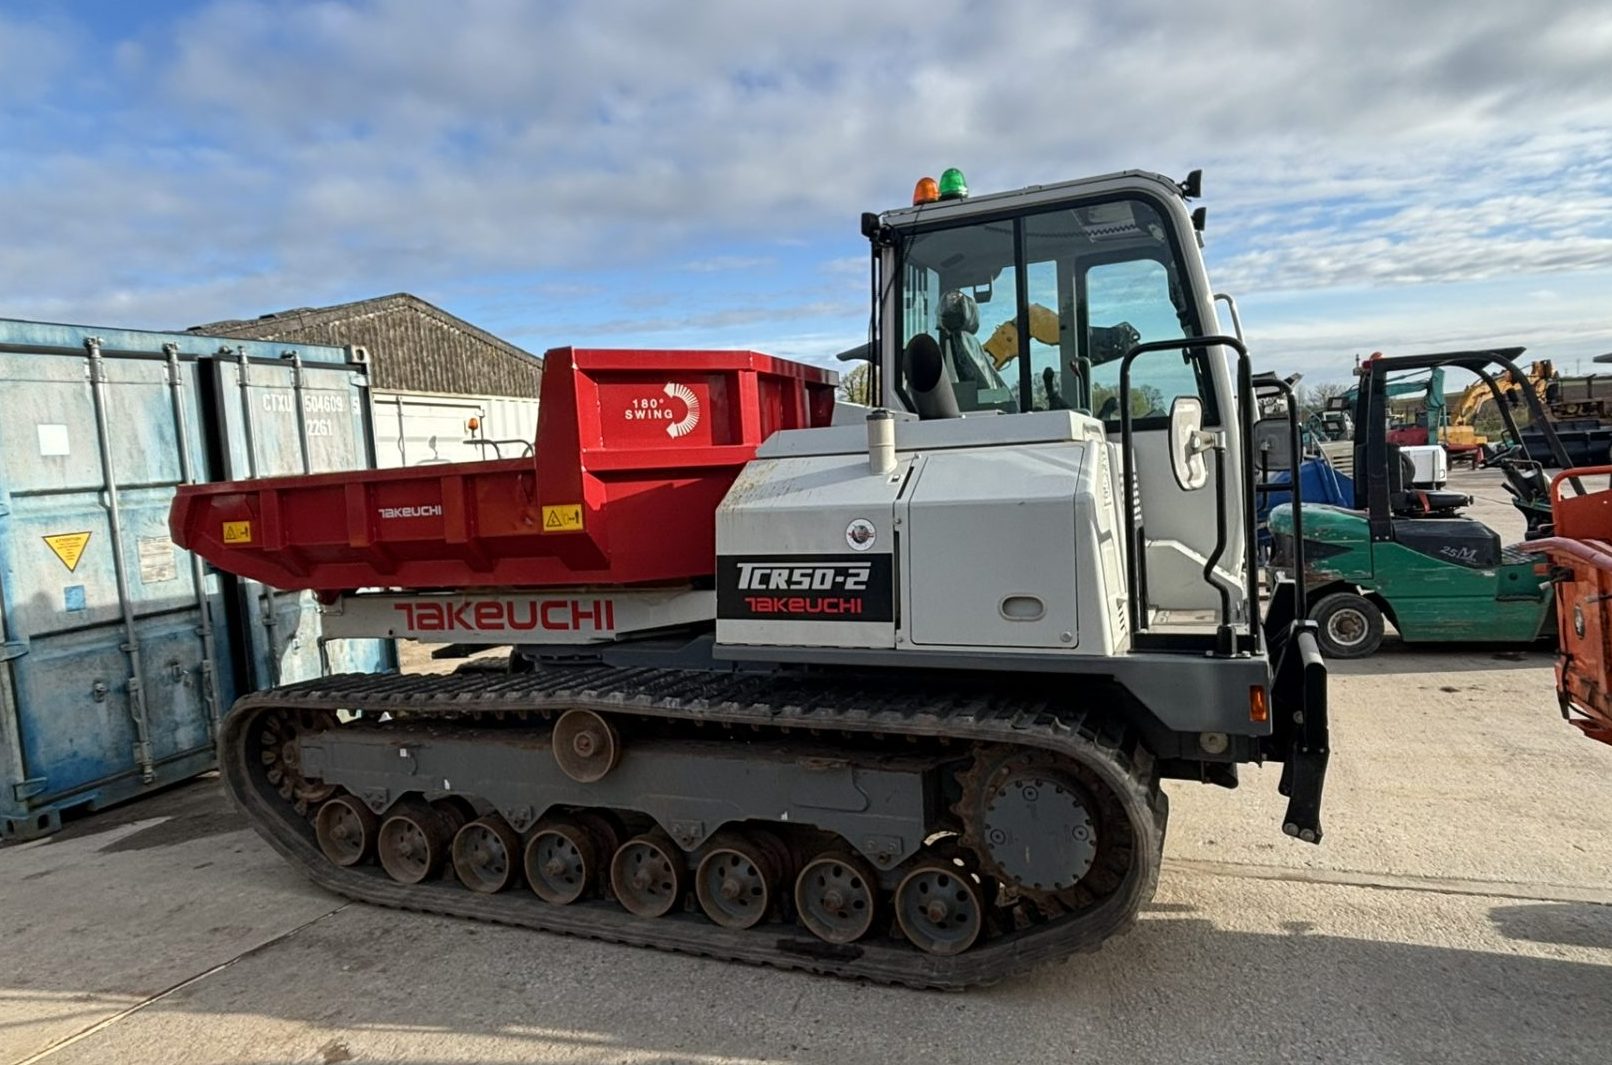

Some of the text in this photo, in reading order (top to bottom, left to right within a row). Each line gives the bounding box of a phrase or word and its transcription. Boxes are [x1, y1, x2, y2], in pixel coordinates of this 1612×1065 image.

[262, 394, 292, 412] CTXU
[304, 395, 344, 412] 504609
[624, 409, 673, 420] SWING
[306, 419, 333, 436] 2261
